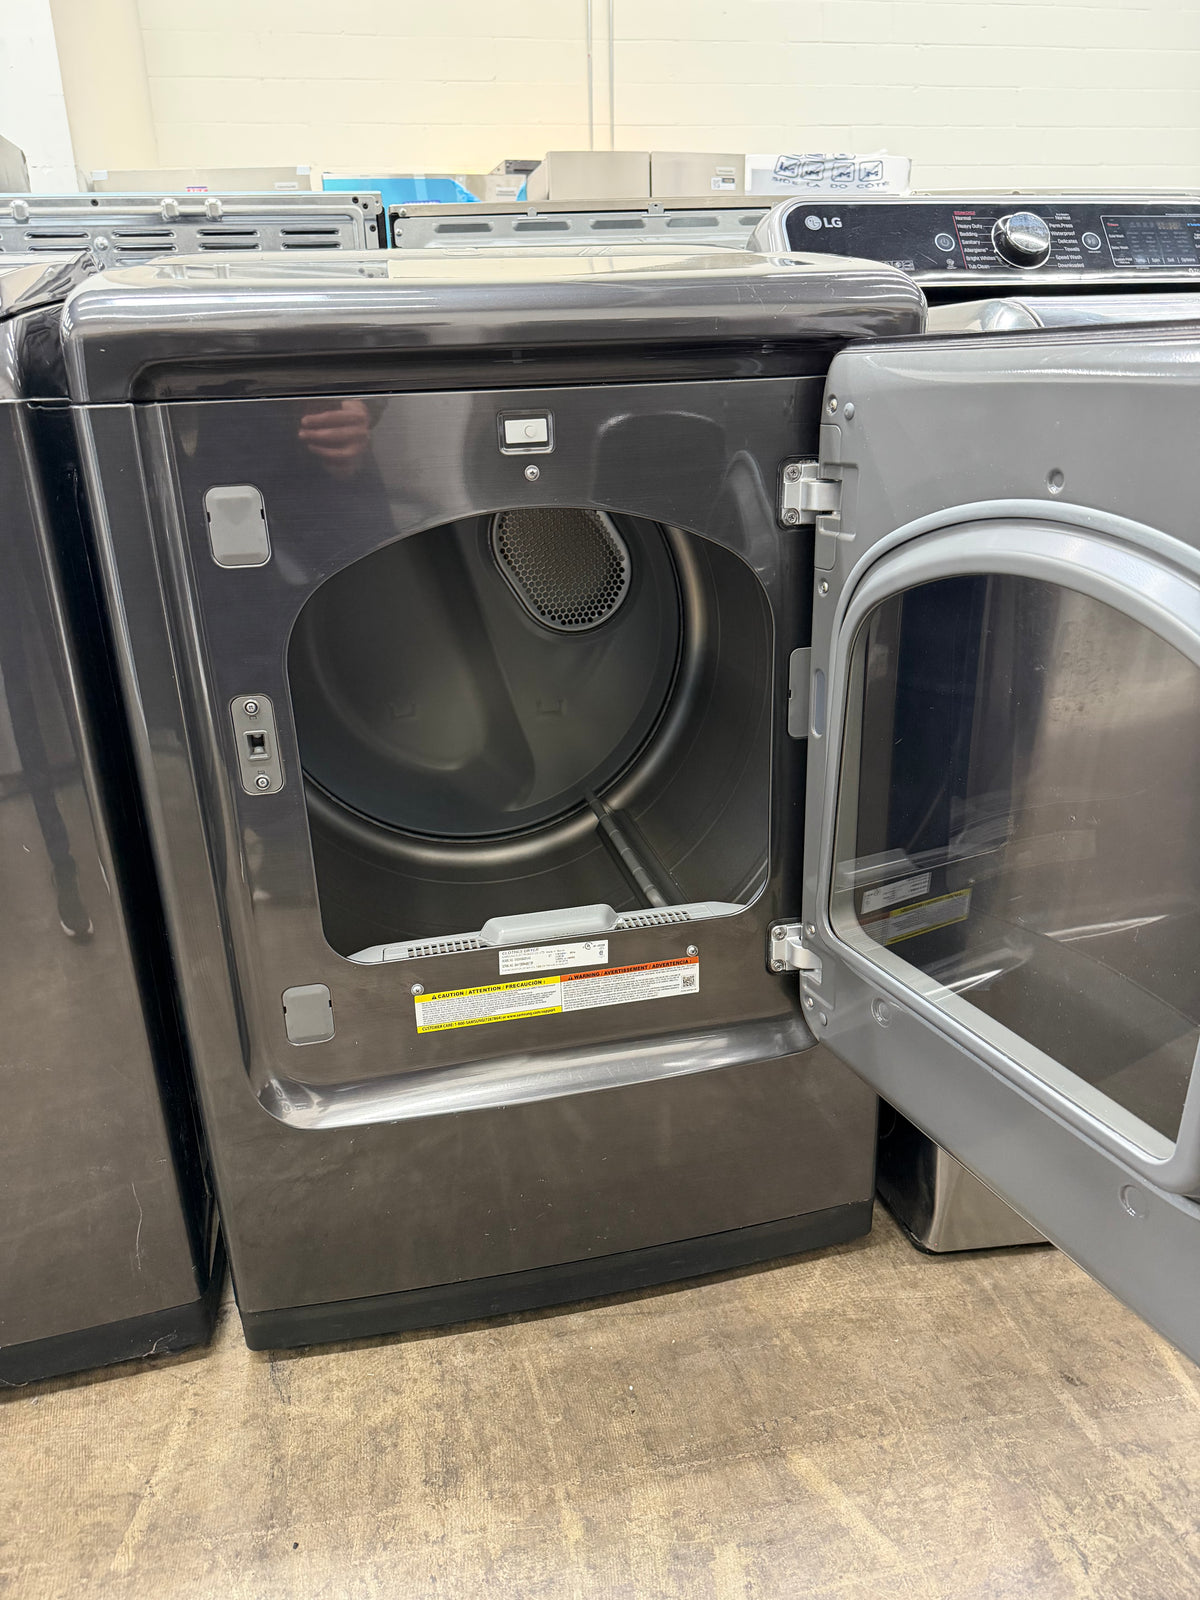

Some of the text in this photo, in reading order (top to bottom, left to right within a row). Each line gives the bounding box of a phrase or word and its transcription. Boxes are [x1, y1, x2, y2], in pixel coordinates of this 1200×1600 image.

[823, 217, 842, 228] LG
[574, 972, 600, 980] WARNING
[604, 965, 648, 976] AVERTISSEMENT
[652, 959, 688, 969] ADVERTENCIA
[437, 991, 464, 999] CAUTION
[469, 986, 501, 995] ATTENTION
[505, 980, 542, 989] PRECAUCIÓN
